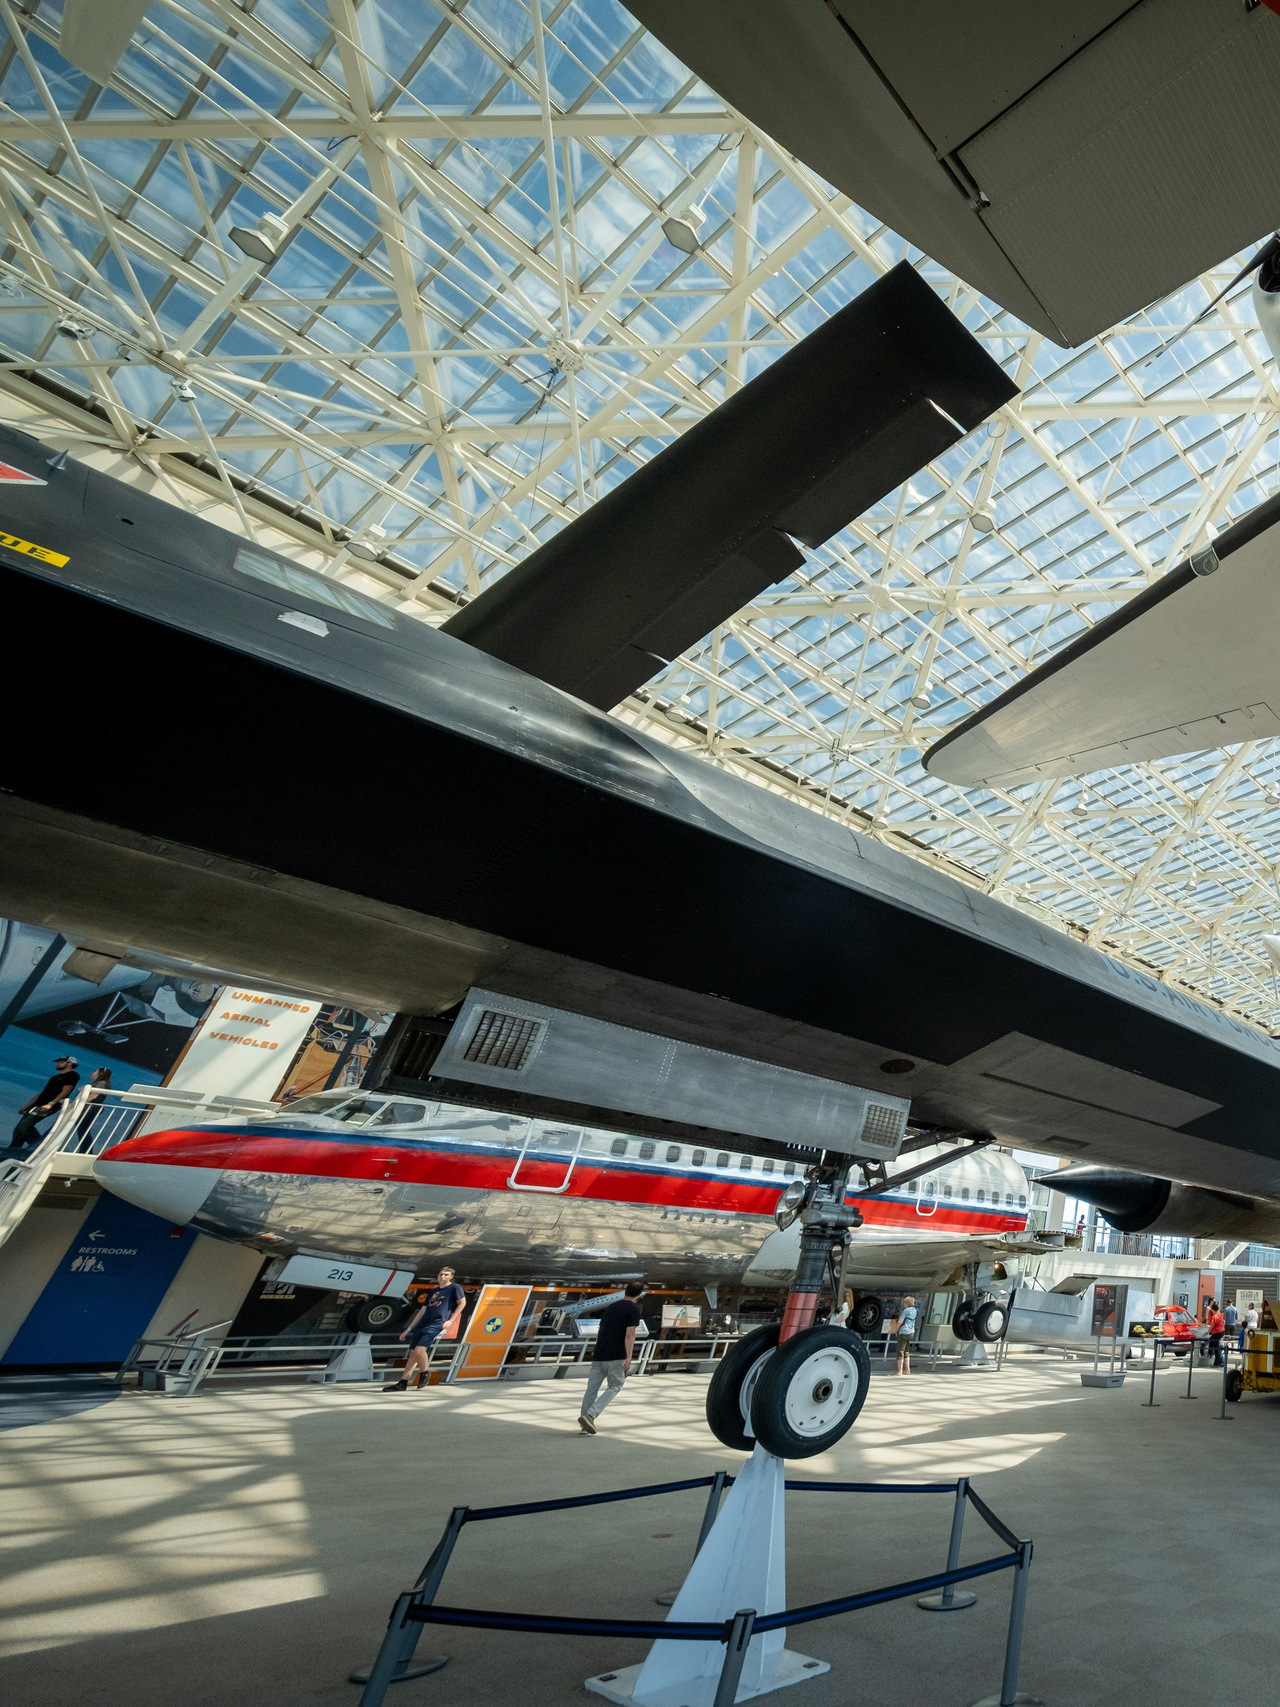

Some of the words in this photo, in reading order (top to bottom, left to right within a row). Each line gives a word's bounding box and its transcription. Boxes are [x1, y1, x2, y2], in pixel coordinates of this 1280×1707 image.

[232, 991, 311, 1014] UNMANNED
[219, 1010, 272, 1028] AERIAL
[209, 1031, 280, 1050] VEHICLES
[78, 1246, 138, 1256] RESTROOMS
[327, 1268, 354, 1281] 213
